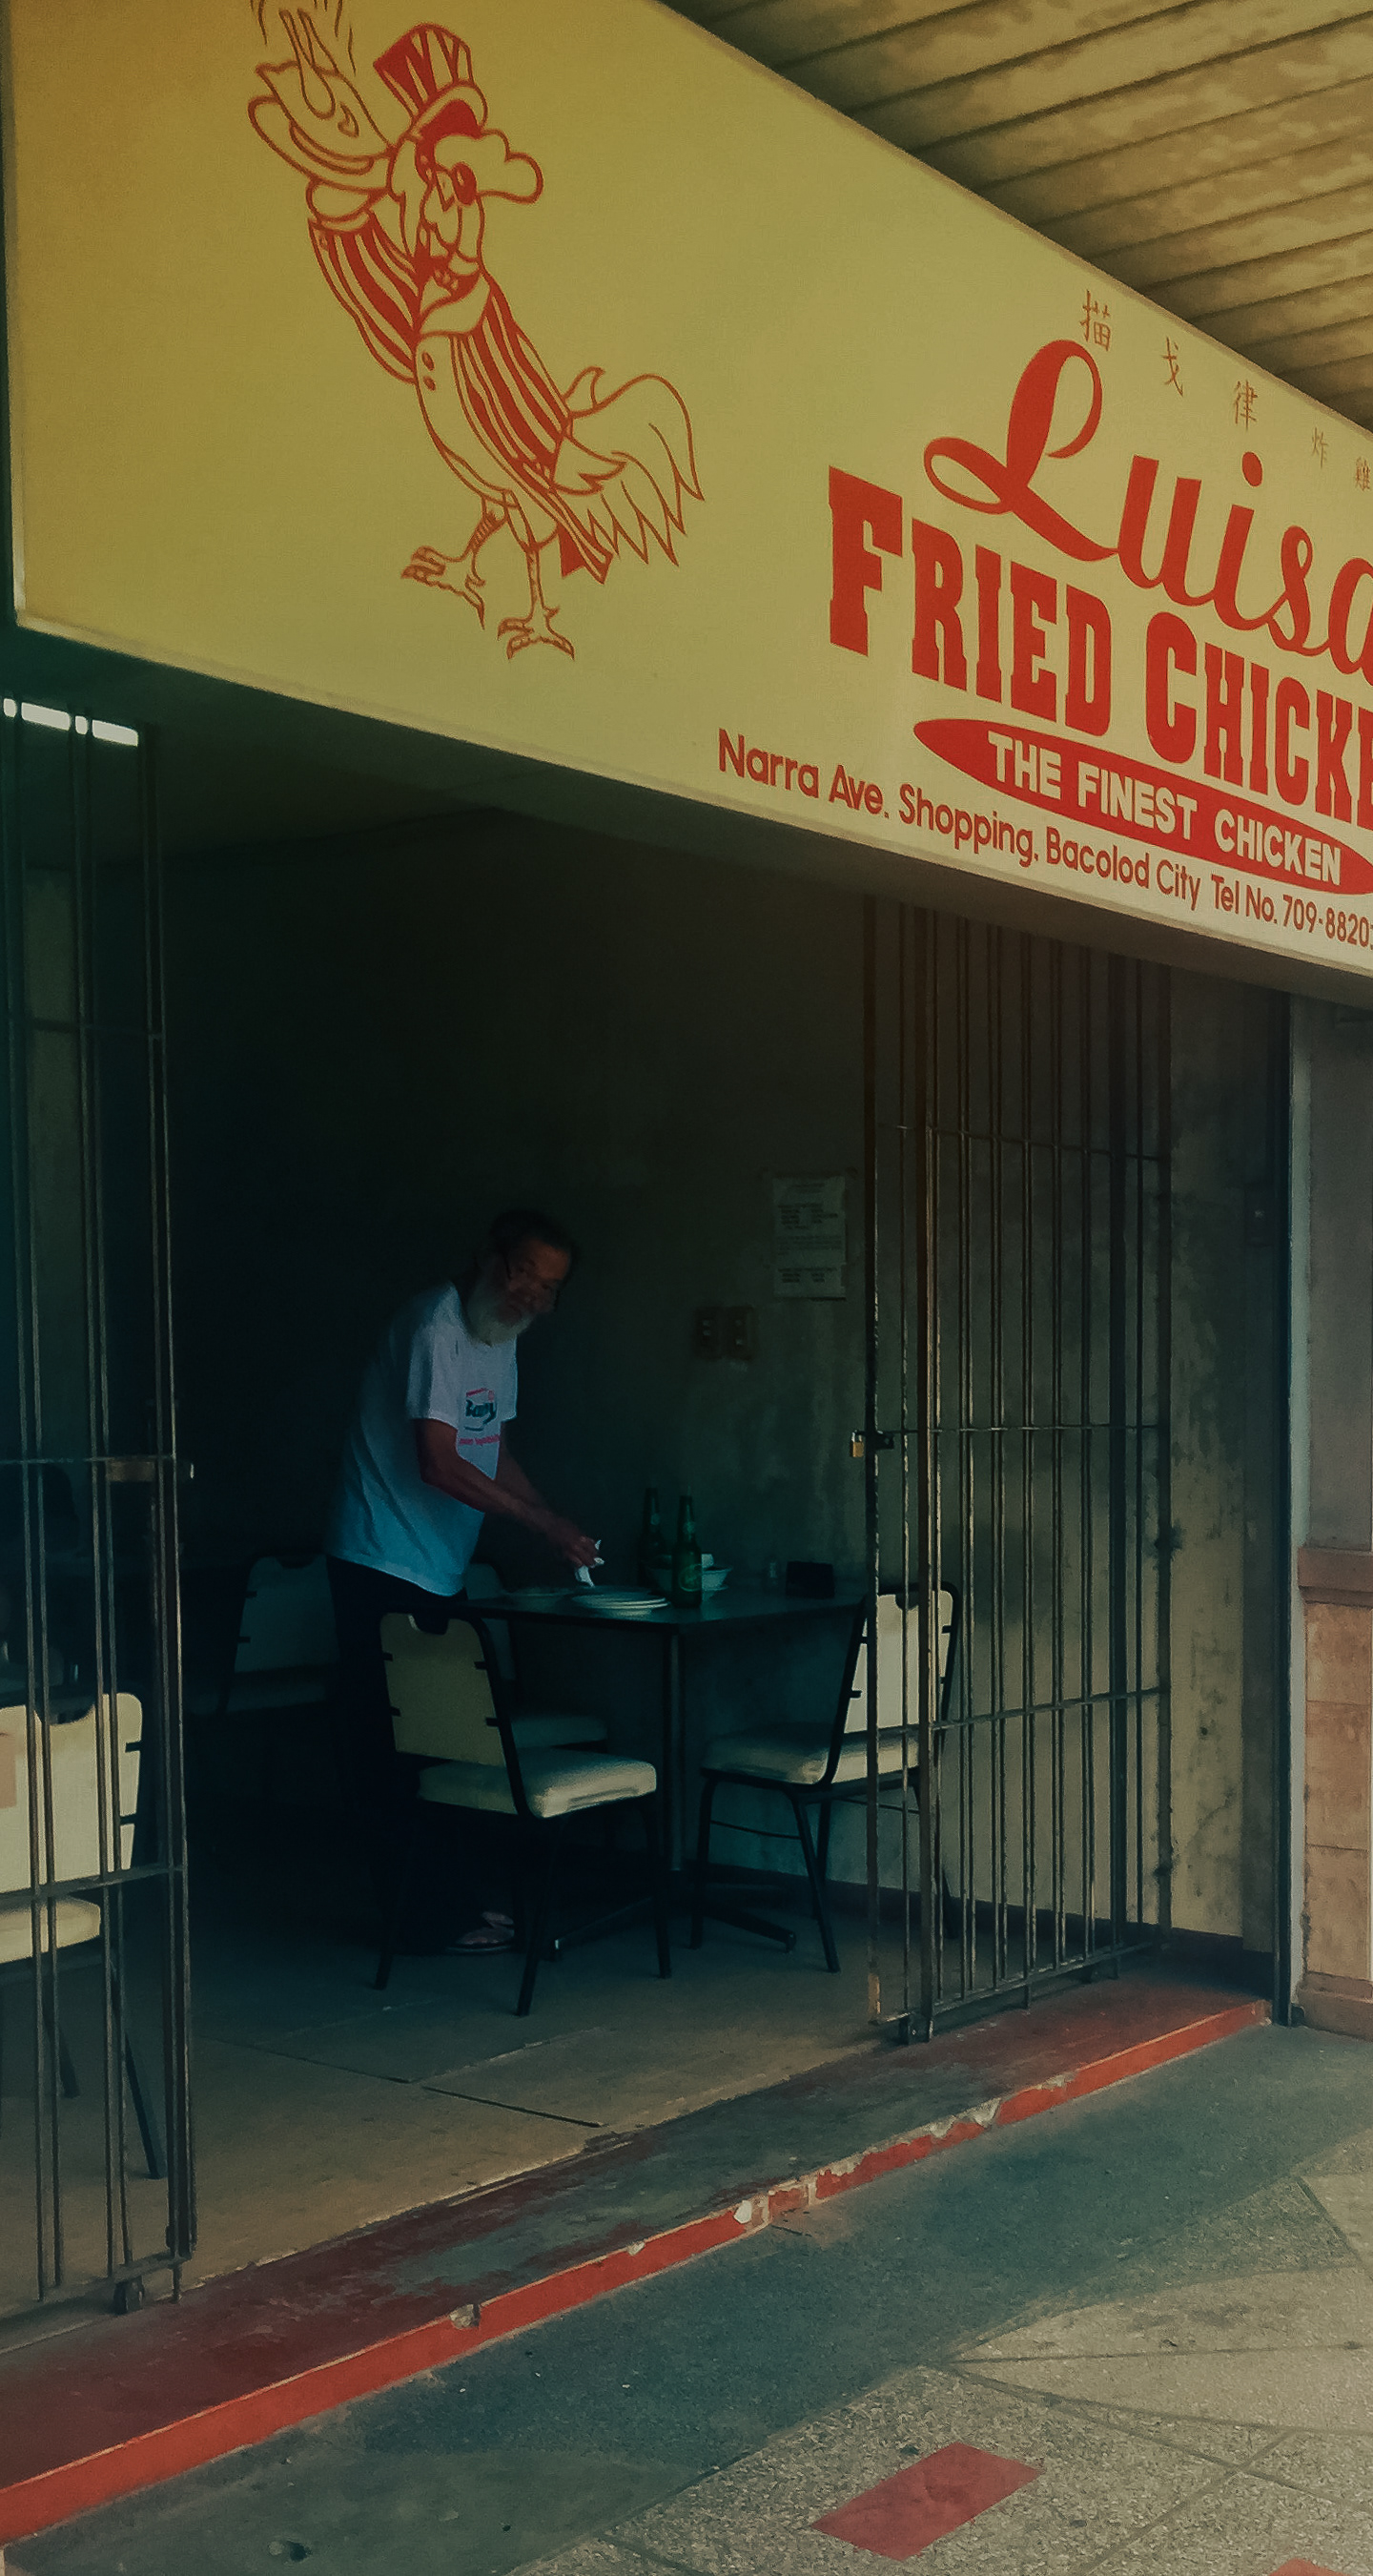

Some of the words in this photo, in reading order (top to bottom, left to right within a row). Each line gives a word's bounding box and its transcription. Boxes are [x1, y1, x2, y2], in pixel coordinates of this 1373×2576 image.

[828, 464, 1112, 737] FRIED
[923, 339, 1373, 687] Luisa
[718, 728, 820, 799] Narra
[828, 764, 890, 819] Ave.
[1046, 826, 1150, 889] Bacolod
[1157, 859, 1200, 911] City
[1211, 874, 1240, 914] Tel
[1246, 884, 1278, 924] No.
[1282, 894, 1373, 950] 709-8820
[988, 731, 1061, 799] THE
[1077, 761, 1198, 840] FINEST
[1214, 809, 1341, 886] CHICKEN
